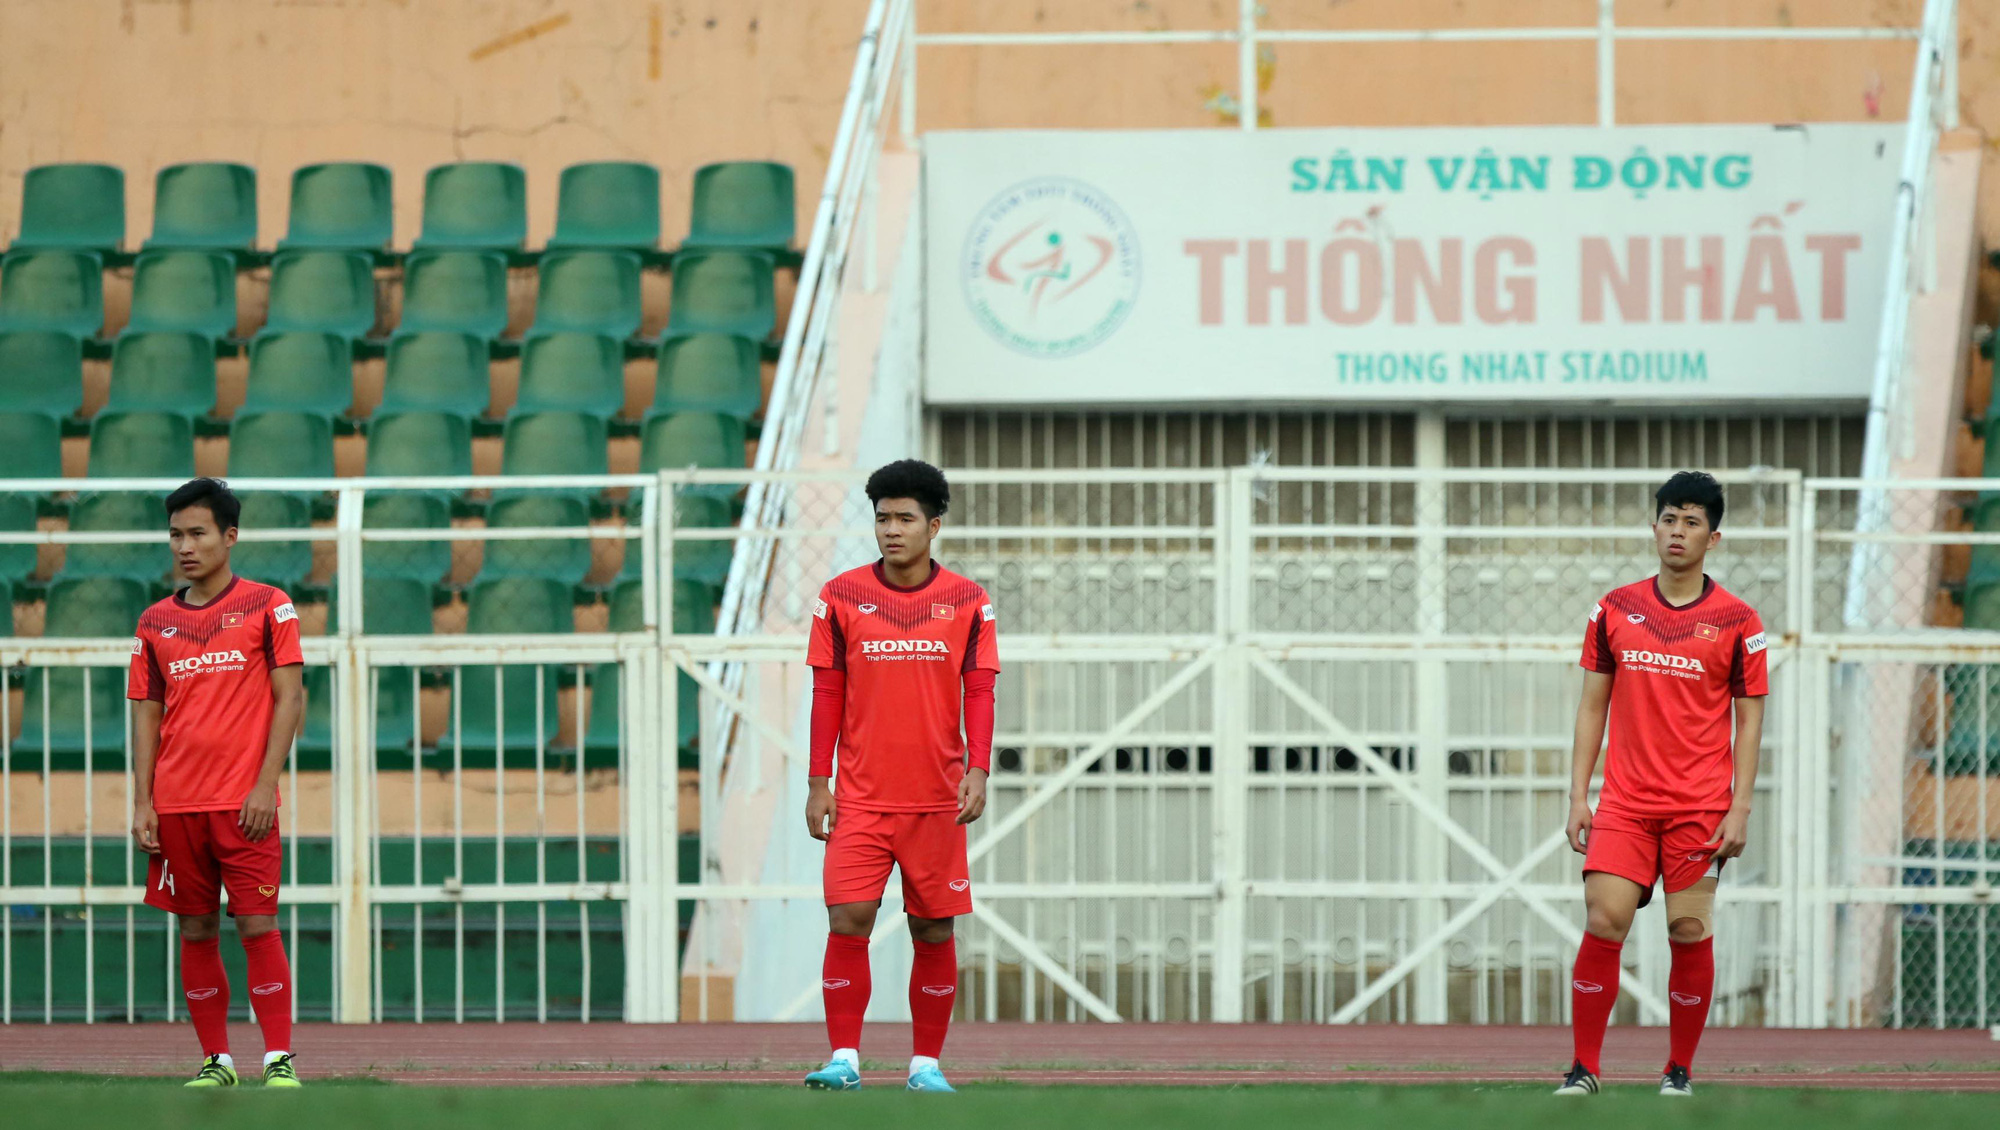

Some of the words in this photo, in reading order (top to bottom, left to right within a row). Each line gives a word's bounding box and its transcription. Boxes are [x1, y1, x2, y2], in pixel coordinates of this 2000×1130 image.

[1290, 147, 1406, 192] SÂN
[1426, 147, 1550, 200] VẬN
[1571, 145, 1752, 200] ĐỘNG
[1183, 202, 1537, 327] THỐNG
[1579, 200, 1862, 324] NHẤT
[1335, 352, 1447, 383] THONG
[1460, 352, 1547, 383] NHAT
[1561, 351, 1709, 383] STADIUM
[861, 639, 950, 653] HONDA
[916, 653, 946, 662] Dreams
[168, 650, 247, 674] HONDA
[216, 664, 244, 672] Dreams
[1621, 650, 1706, 672] HONDA
[1639, 664, 1661, 674] Power
[1671, 669, 1701, 681] Dreams
[158, 859, 175, 897] 14
